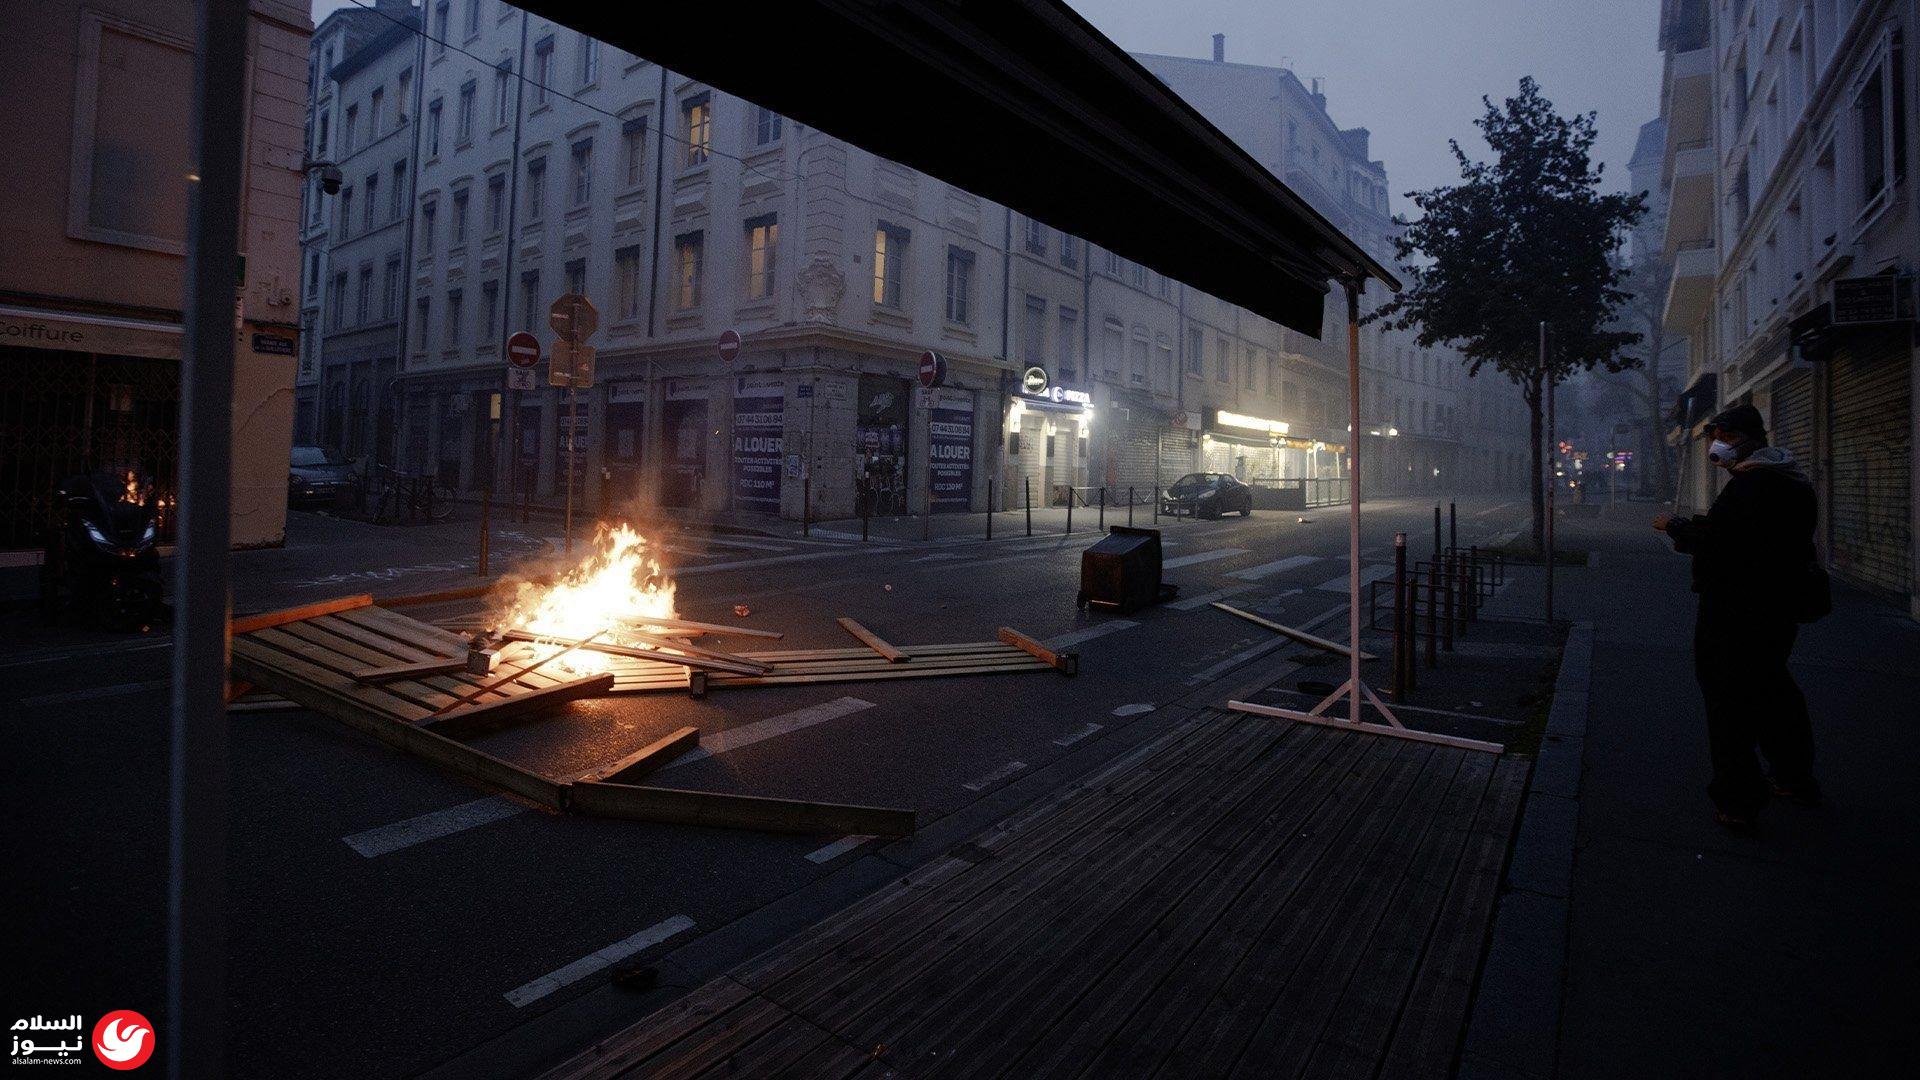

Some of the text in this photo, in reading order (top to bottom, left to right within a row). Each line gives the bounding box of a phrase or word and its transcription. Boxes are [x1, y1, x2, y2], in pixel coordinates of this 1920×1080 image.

[735, 437, 783, 453] A LOUER
[930, 444, 970, 460] A LOUER
